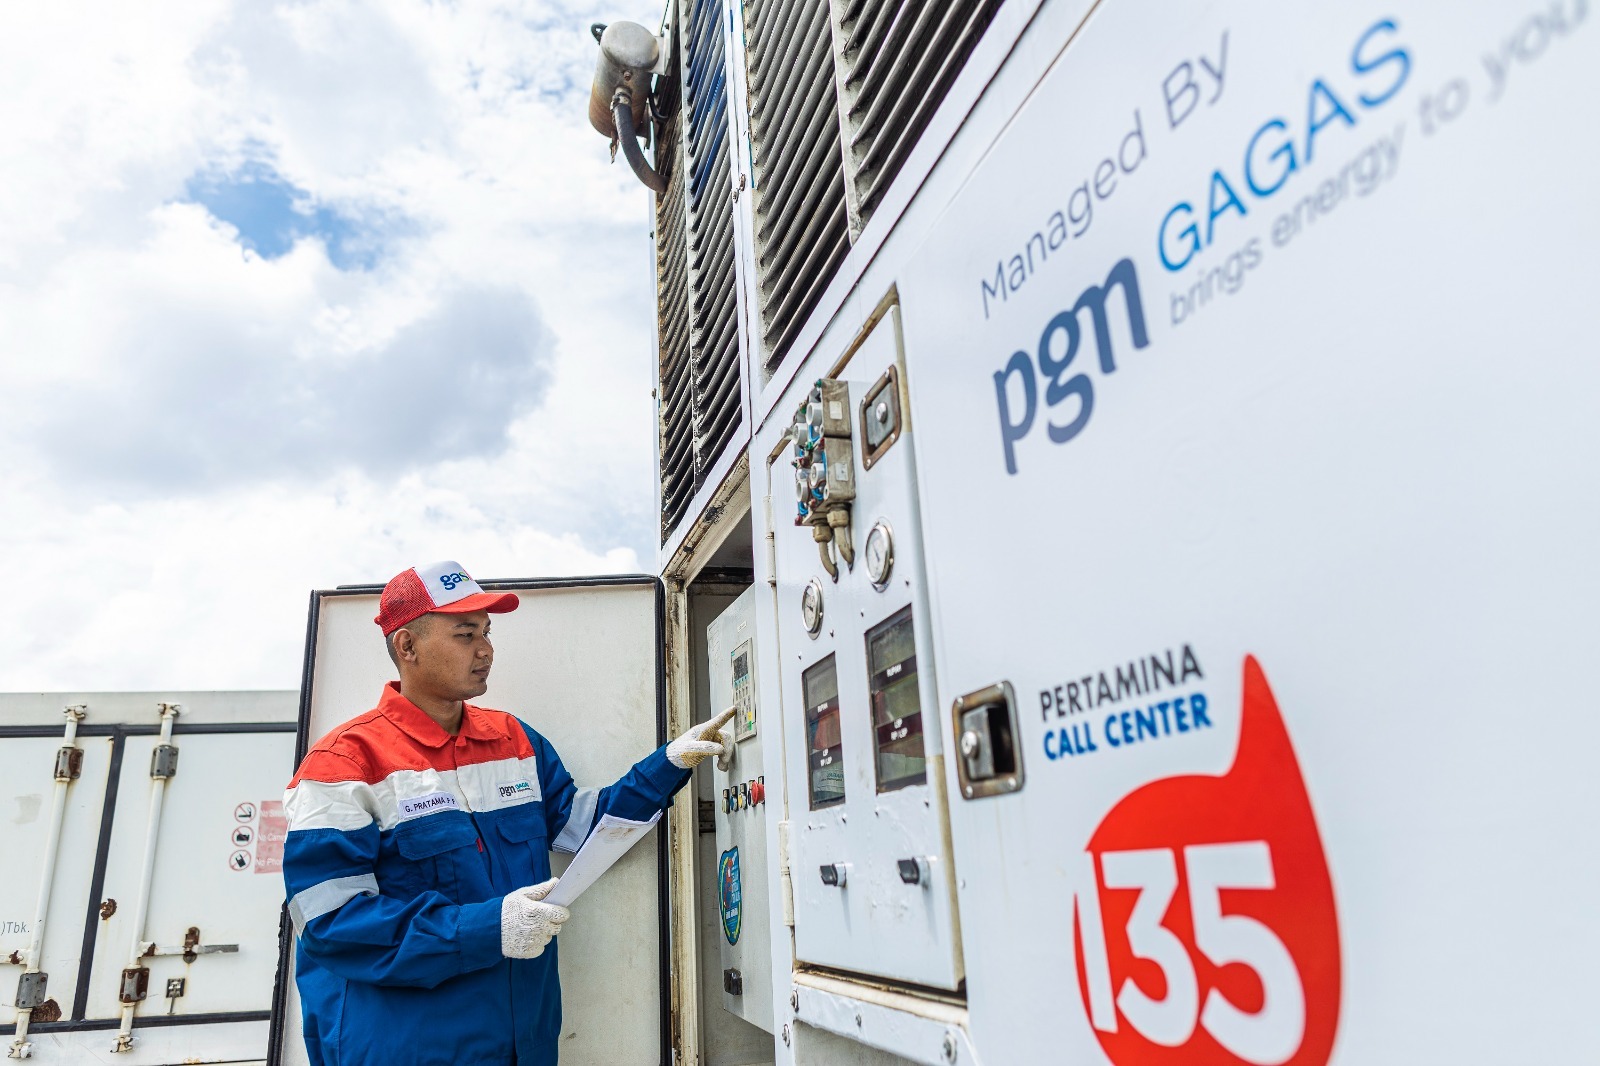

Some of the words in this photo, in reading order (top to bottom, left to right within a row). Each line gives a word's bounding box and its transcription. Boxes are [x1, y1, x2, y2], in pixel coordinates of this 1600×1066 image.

[981, 109, 1148, 320] Managed
[1161, 28, 1231, 131] By
[1157, 16, 1414, 274] GAGAS
[1168, 238, 1264, 327] brings
[1270, 122, 1407, 250] energy
[1418, 76, 1471, 137] to
[992, 257, 1151, 476] pgn
[440, 571, 469, 590] gas
[1039, 643, 1205, 723] PERTAMINA
[1043, 720, 1098, 761] CALL
[1104, 693, 1213, 749] CENTER
[405, 805, 413, 813] G.
[413, 797, 446, 811] PRATAMA
[499, 785, 516, 797] pgn
[1075, 839, 1307, 1066] 135
